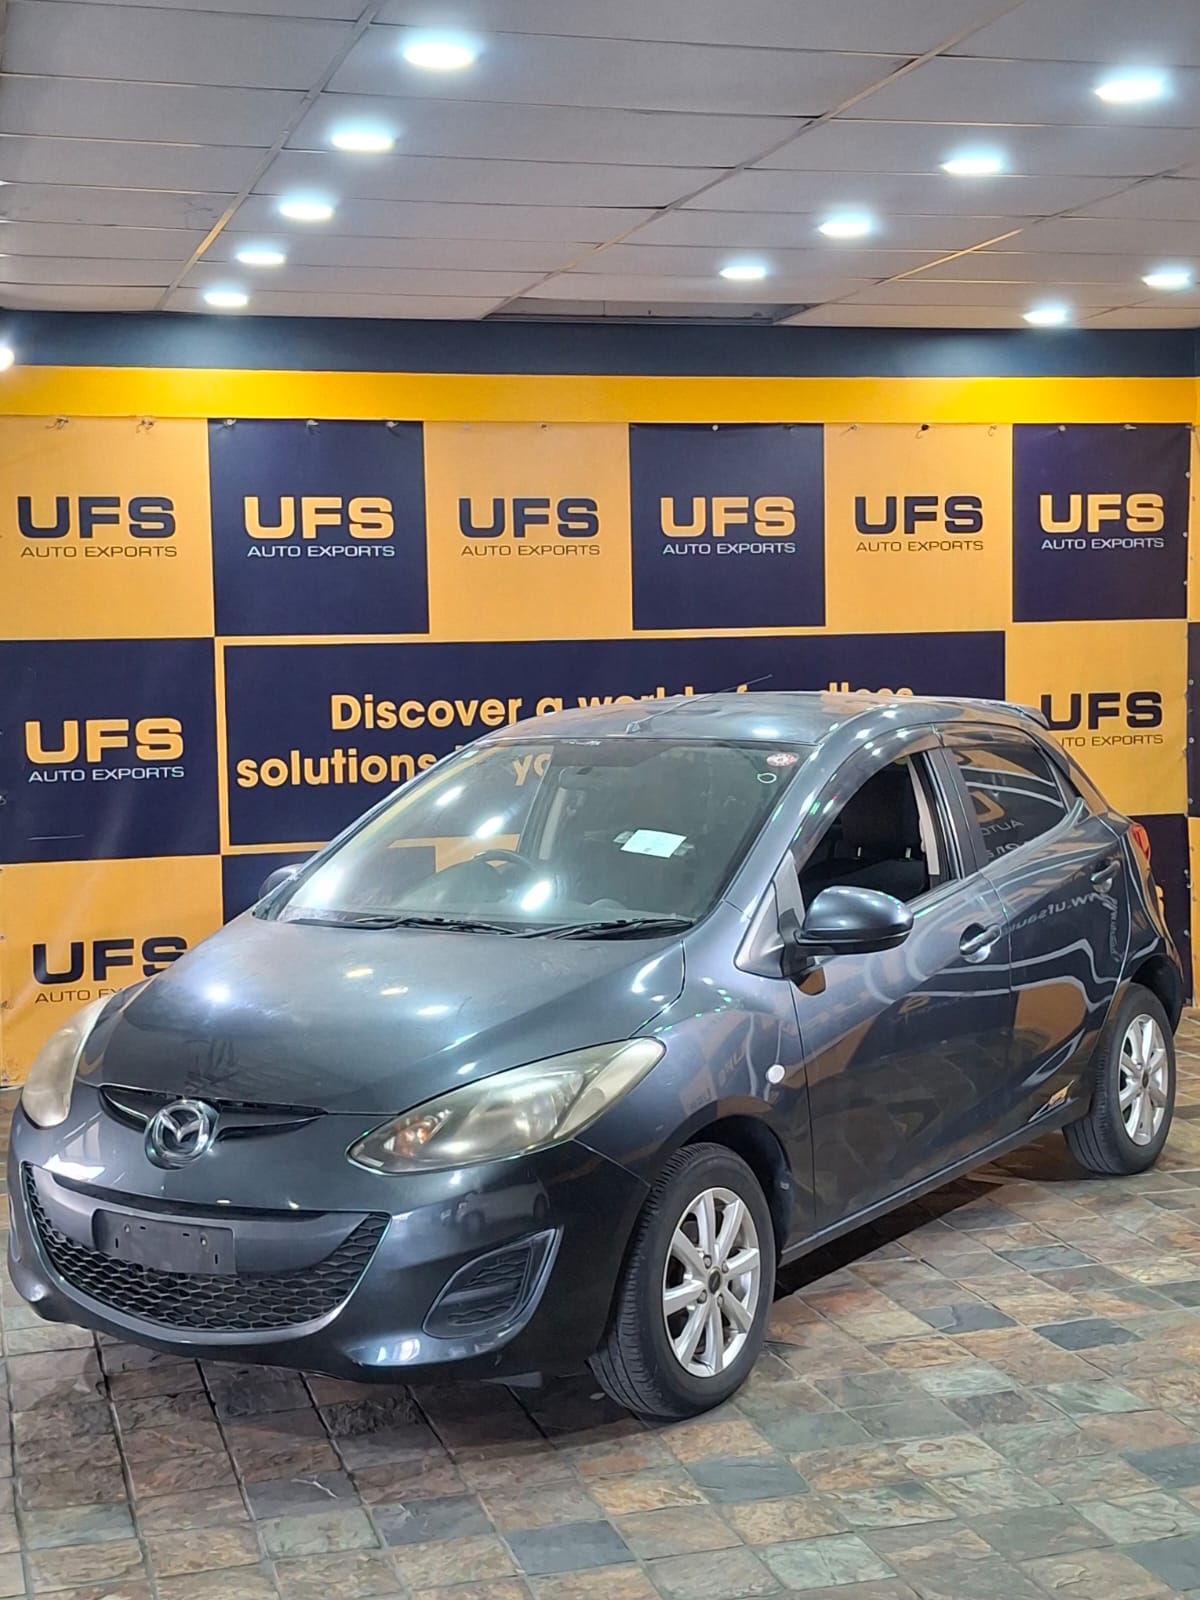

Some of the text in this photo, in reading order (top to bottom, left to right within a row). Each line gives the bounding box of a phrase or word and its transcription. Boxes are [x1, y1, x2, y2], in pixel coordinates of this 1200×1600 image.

[17, 494, 177, 540] UFS
[244, 496, 395, 541] UFS
[457, 498, 599, 539] UFS
[659, 496, 797, 539] UFS
[855, 494, 984, 535] UFS
[1039, 493, 1165, 534] UFS
[21, 546, 177, 558] AUTO EXPORTS
[247, 545, 395, 558] AUTO EXPORTS
[462, 545, 600, 556] AUTO EXPORTS
[663, 543, 796, 556] AUTO EXPORTS
[856, 541, 984, 552] AUTO EXPORTS
[1041, 537, 1164, 550] AUTO EXPORTS
[330, 693, 523, 731] Discover
[1041, 691, 1163, 731] UFS
[24, 718, 184, 765] UFS
[1062, 734, 1164, 748] TO EXPORTS
[29, 767, 185, 782] AUTO EXPORTS
[236, 747, 437, 789] solutions
[32, 936, 188, 984] UFS
[35, 989, 90, 1004] AUTO
